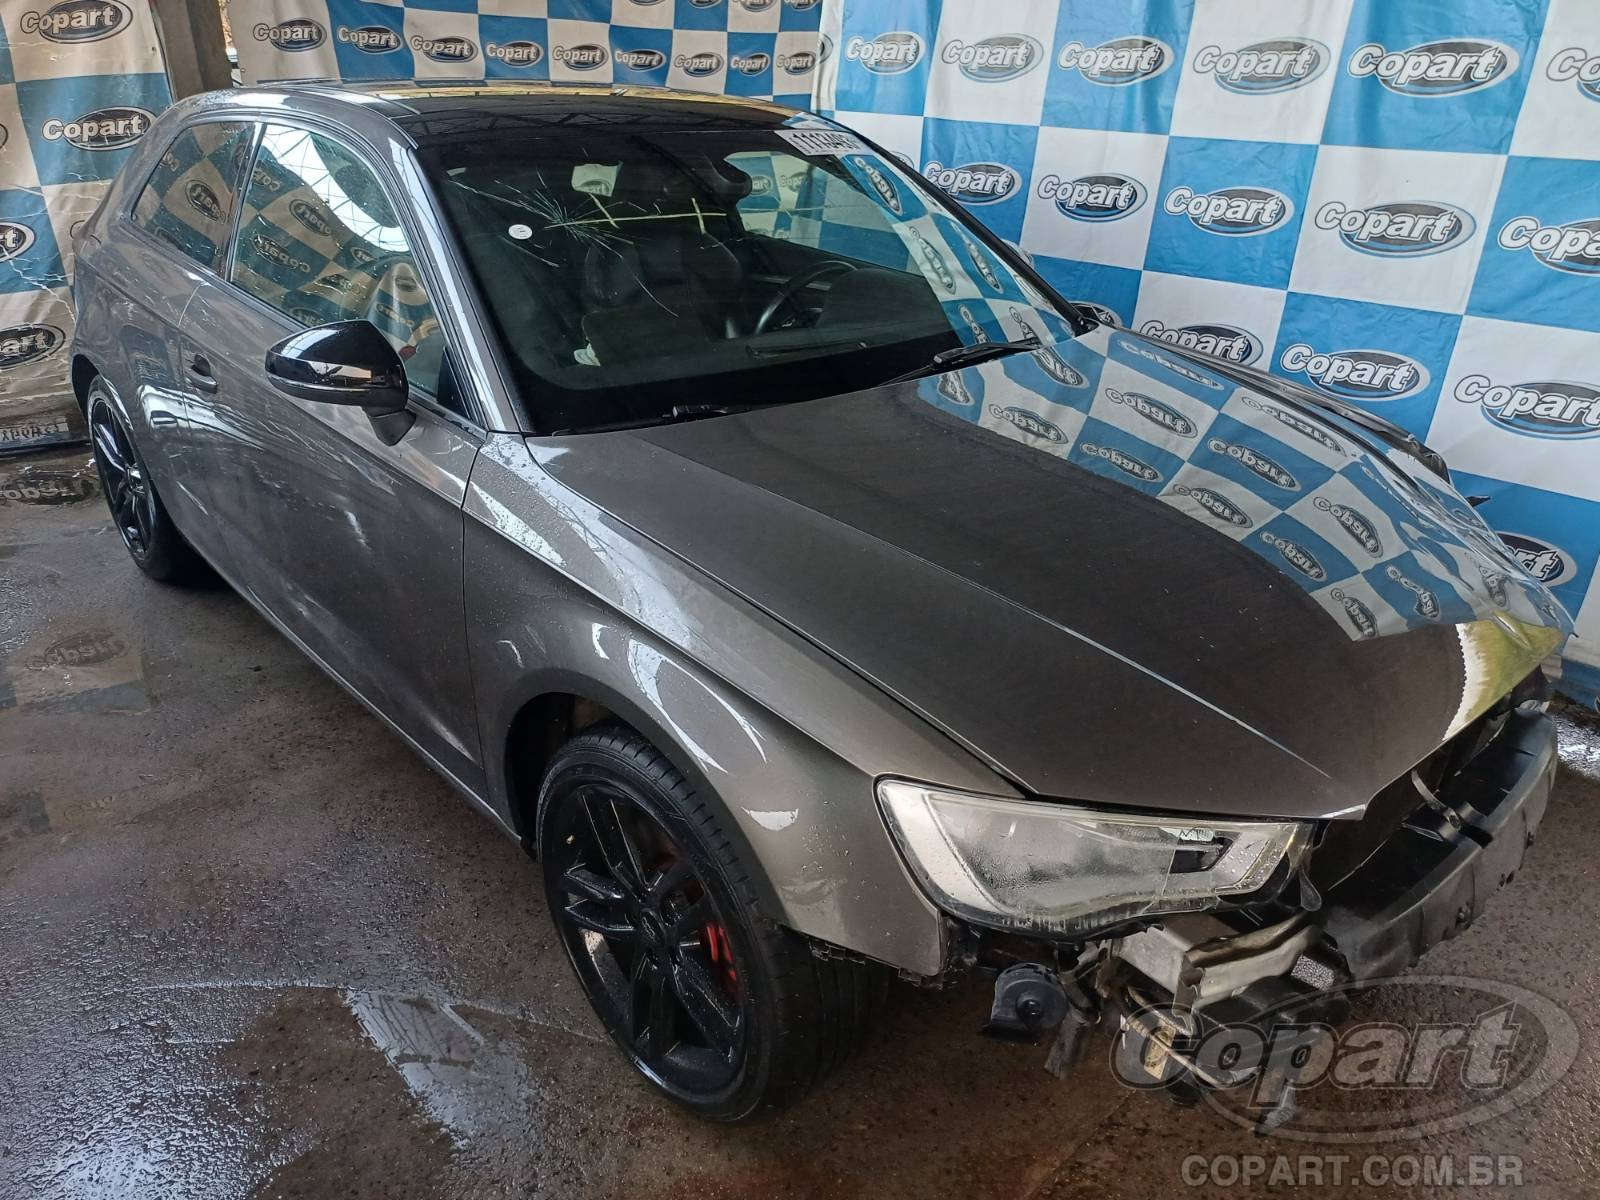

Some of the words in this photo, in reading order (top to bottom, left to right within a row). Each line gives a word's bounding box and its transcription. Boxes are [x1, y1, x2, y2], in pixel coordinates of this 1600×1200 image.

[21, 5, 115, 34] Copart
[253, 22, 319, 44] Copart
[337, 25, 398, 47] Copart
[410, 35, 471, 57] Copart
[486, 42, 537, 61] Copart
[552, 45, 602, 62] Copart
[614, 49, 660, 67] Copart
[673, 53, 719, 71] Copart
[730, 55, 769, 71] Copart
[776, 53, 815, 69] Copart
[846, 37, 918, 67] Copart
[941, 40, 1032, 70] Copart
[1058, 40, 1161, 76] Copart
[1194, 45, 1314, 77] Copart
[1348, 44, 1502, 87] Copart
[42, 114, 144, 142] Copart
[923, 161, 1013, 196] Copart
[1037, 175, 1135, 209] Copart
[1164, 186, 1281, 225] Copart
[1315, 201, 1457, 243] Copart
[1280, 344, 1415, 392] Copart
